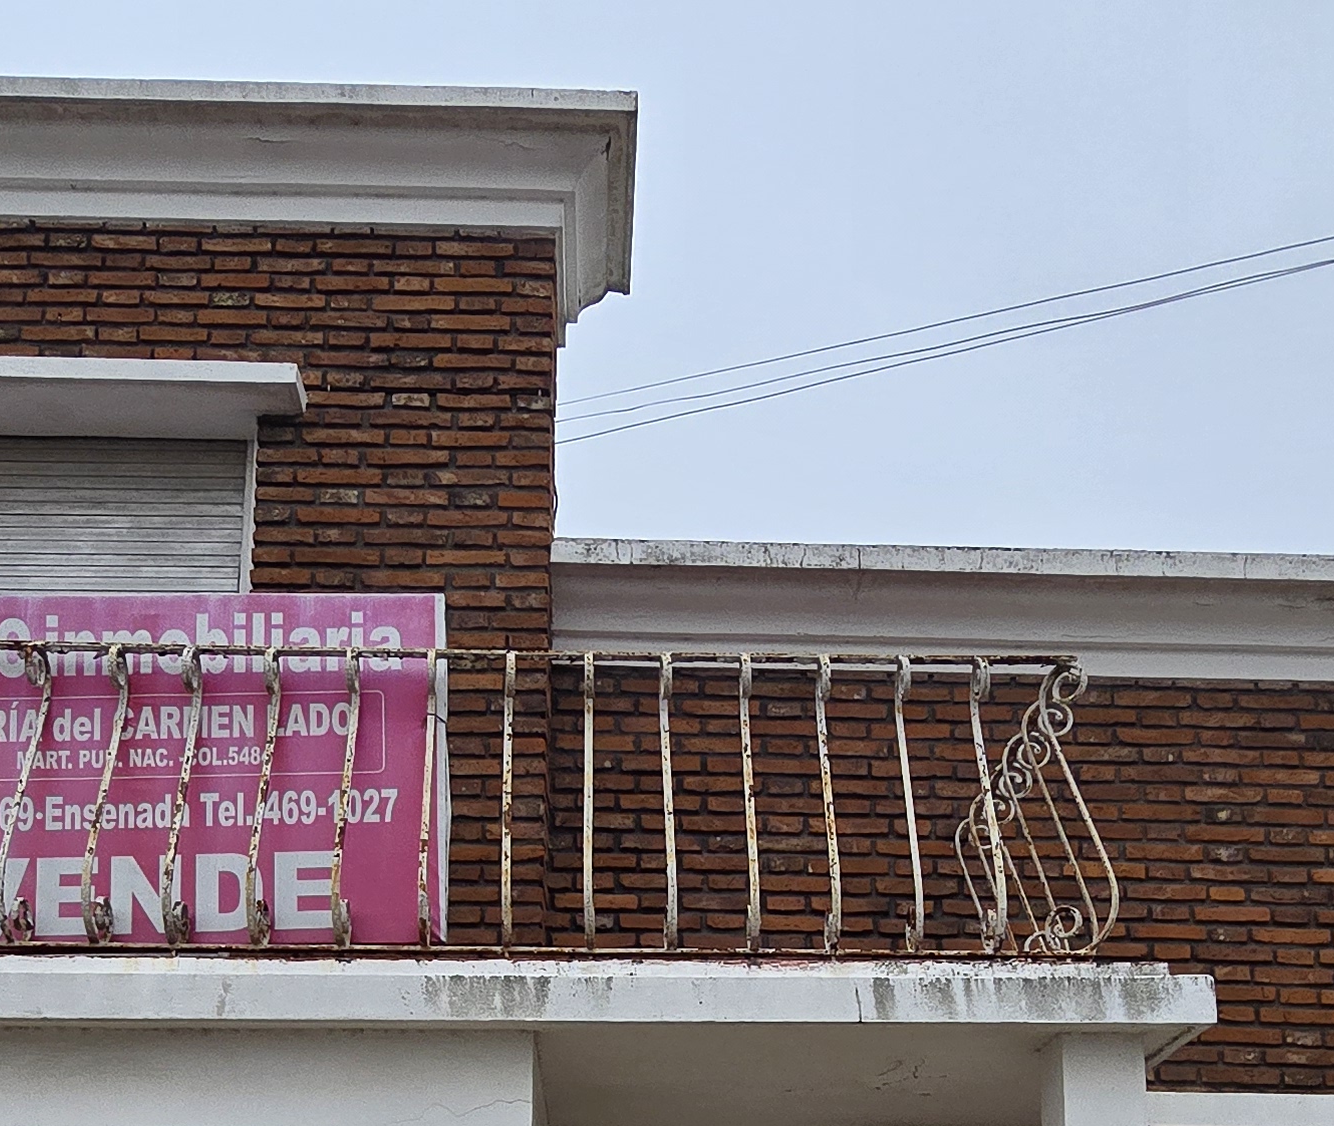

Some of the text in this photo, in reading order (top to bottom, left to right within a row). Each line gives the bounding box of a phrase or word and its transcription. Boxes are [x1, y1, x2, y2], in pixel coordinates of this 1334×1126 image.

[45, 611, 402, 677] inmobiliaria
[53, 708, 101, 742] del
[114, 705, 254, 740] CARMEN
[79, 749, 123, 769] PU.
[129, 748, 174, 768] NAC.
[200, 792, 253, 827] Tel.
[264, 789, 398, 825] 469-1027
